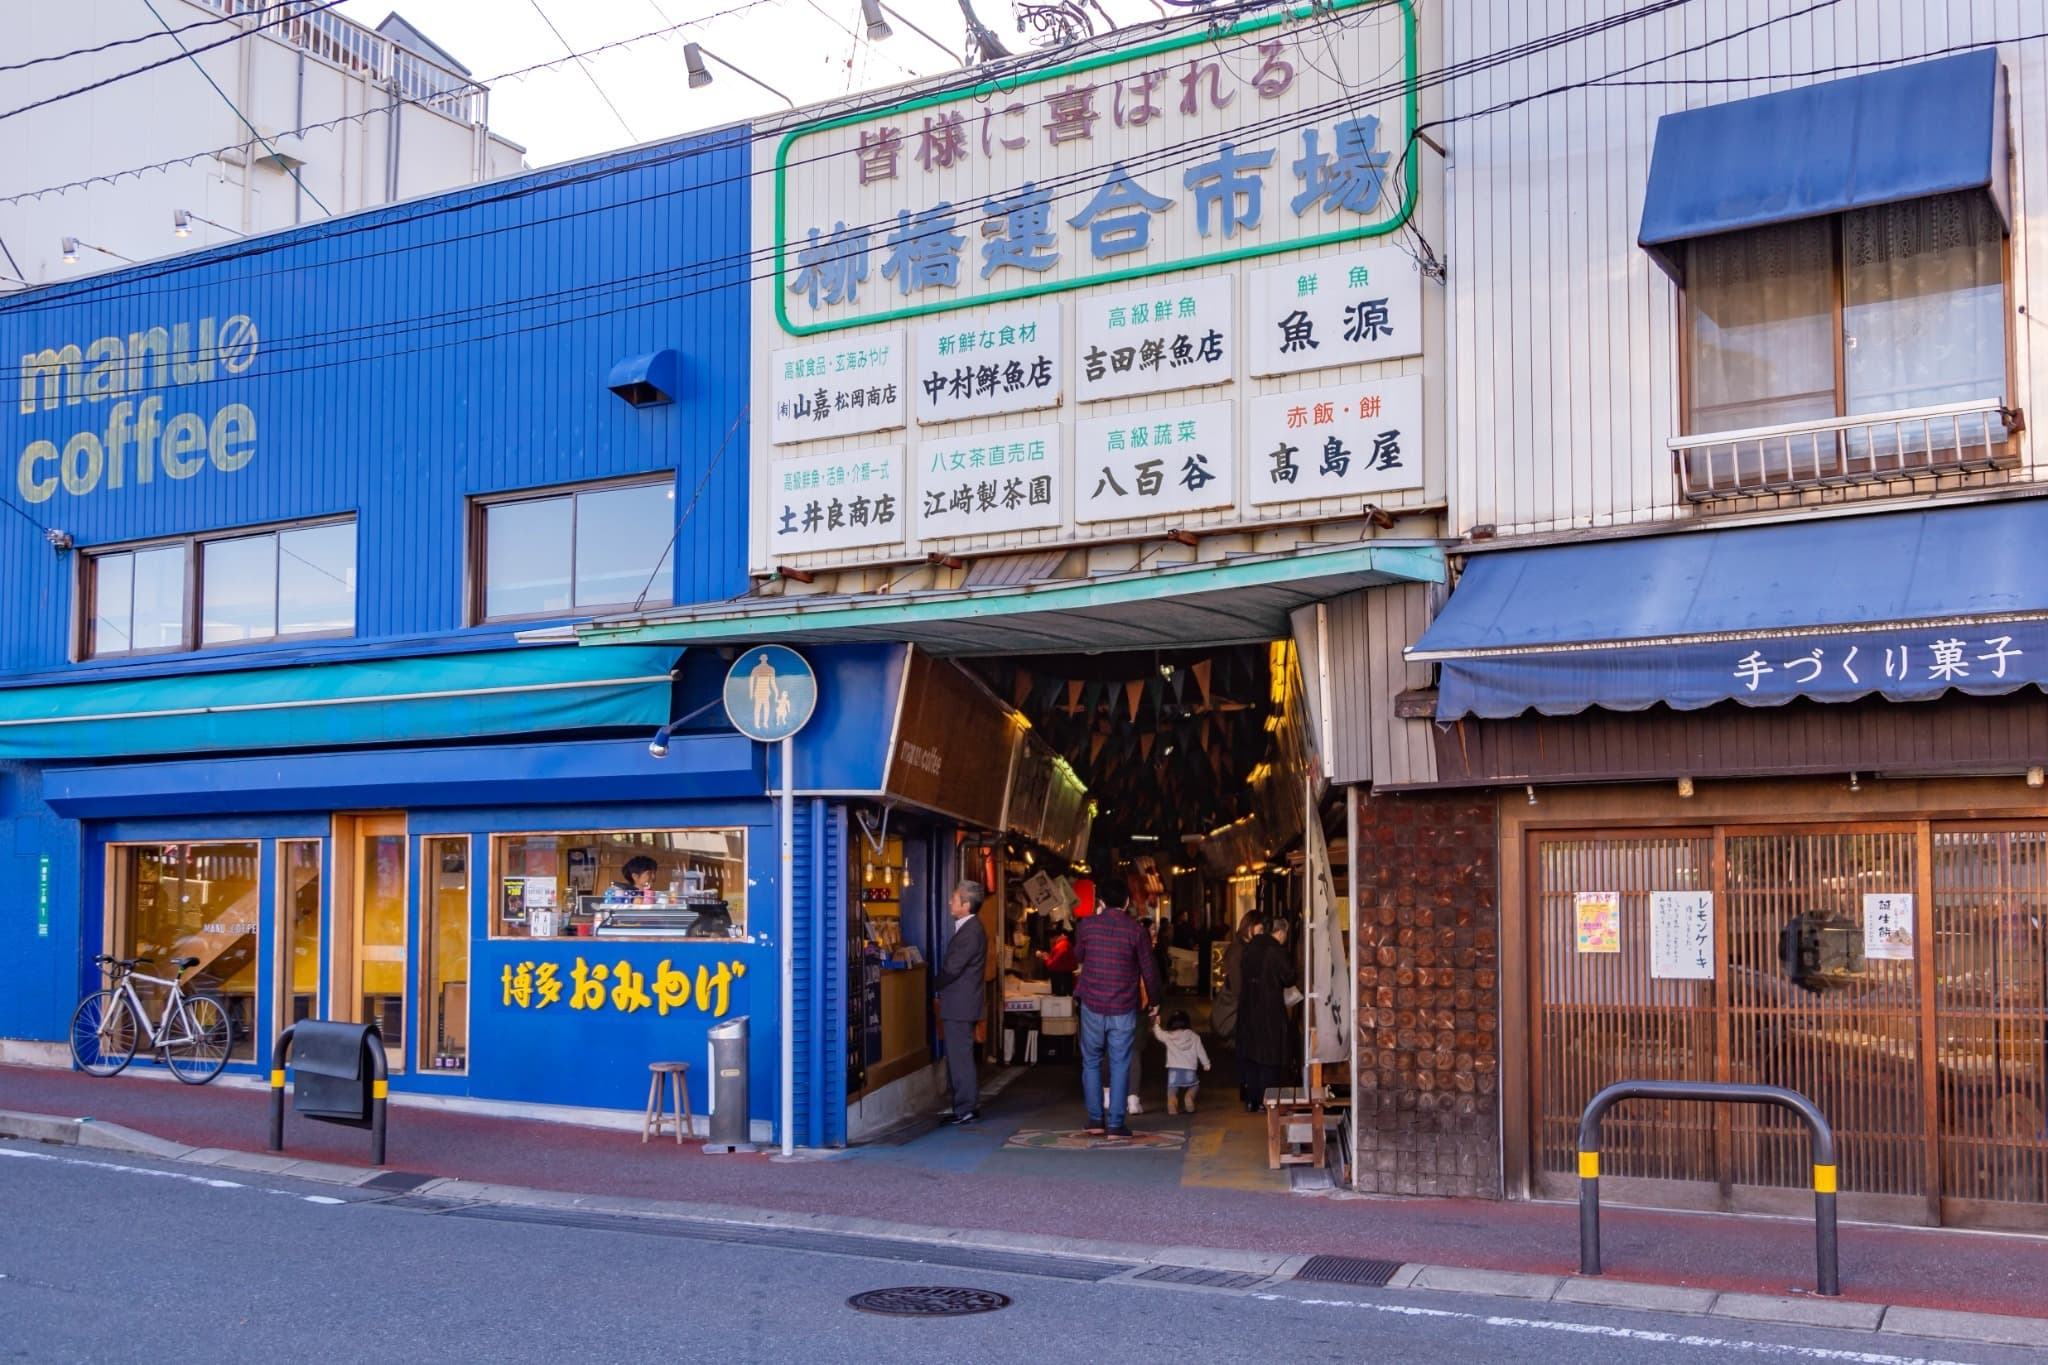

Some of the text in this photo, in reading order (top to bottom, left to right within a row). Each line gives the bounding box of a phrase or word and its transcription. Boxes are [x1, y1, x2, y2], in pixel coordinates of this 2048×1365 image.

[854, 40, 1301, 187] 皆様に喜ばれる
[788, 114, 1394, 310] 柳橋連合市場
[1297, 265, 1369, 298] 鮮魚
[938, 321, 1037, 356] 新鮮な食材
[1108, 296, 1197, 329] 高級鮮魚
[1277, 297, 1394, 354] 魚源
[20, 316, 217, 415] manu
[922, 355, 1053, 407] 中村鮮魚店
[1083, 328, 1224, 383] 吉田鮮魚店
[1286, 395, 1381, 429] 赤飯・餅
[17, 395, 257, 504] coffee
[931, 440, 1046, 472] 八女茶直売店
[1091, 453, 1216, 500] 八百谷
[776, 493, 896, 535] 土井良商店
[1733, 635, 2024, 691] 手づくり菓子
[1696, 897, 1709, 968] レモンケーキ
[501, 957, 747, 1017] 博多おみやげ
